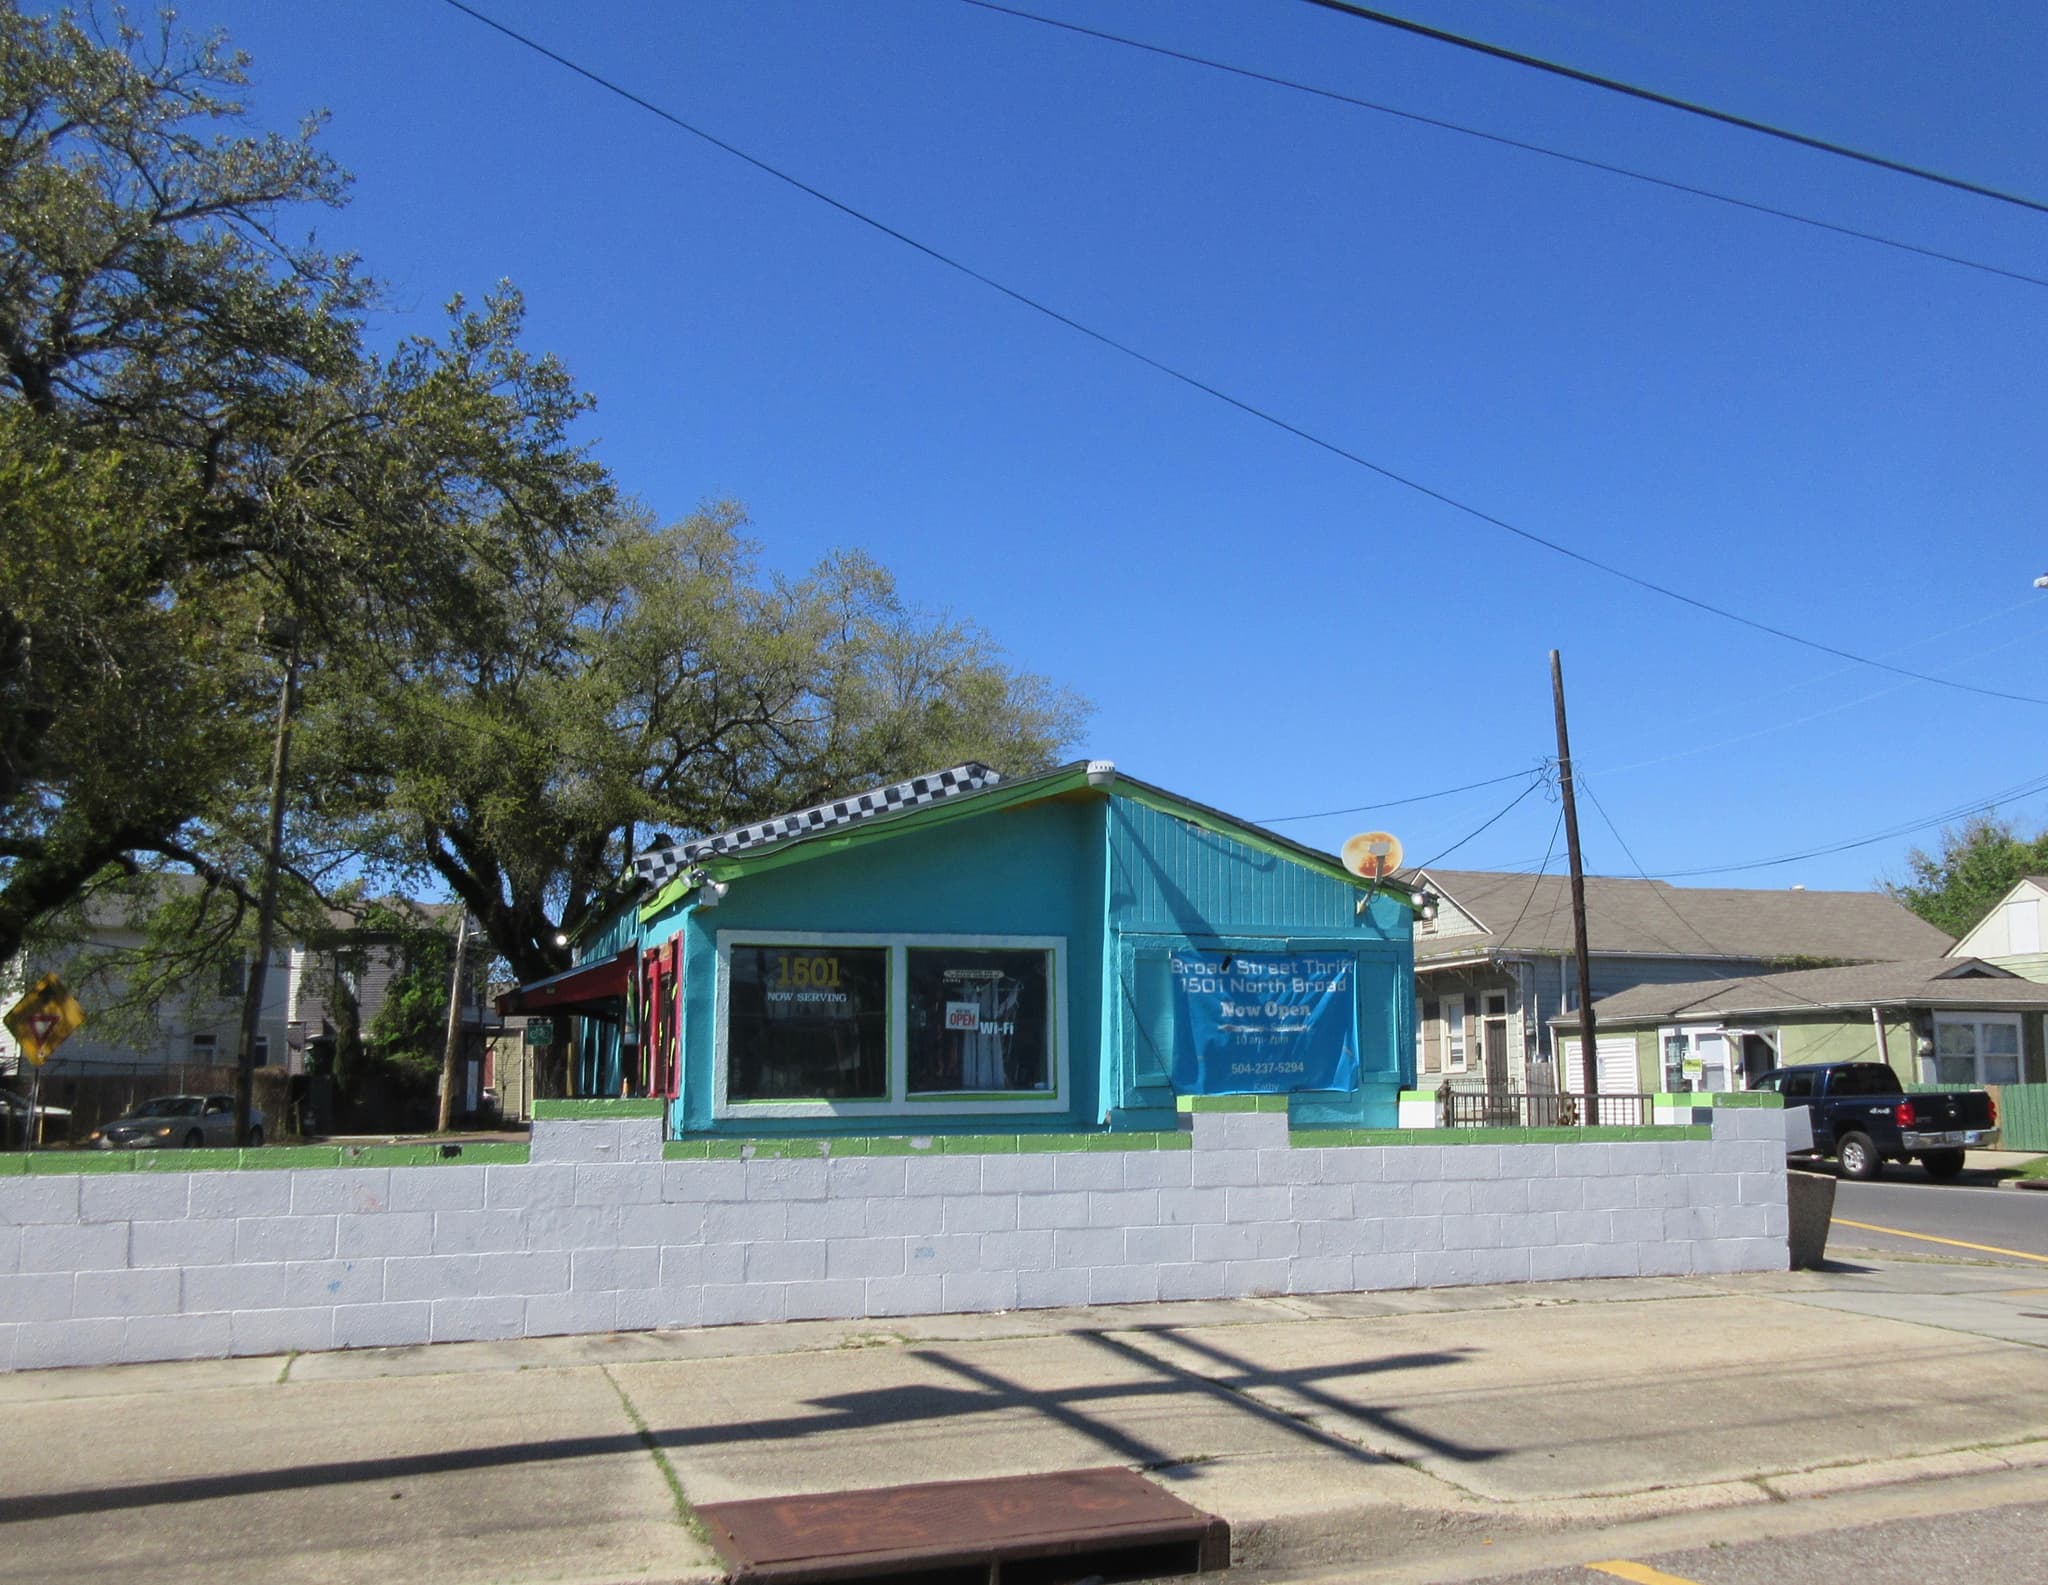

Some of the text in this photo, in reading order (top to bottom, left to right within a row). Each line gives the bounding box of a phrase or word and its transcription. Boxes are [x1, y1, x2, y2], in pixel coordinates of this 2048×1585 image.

[777, 957, 841, 987] 1501
[1170, 959, 1353, 975] Broad Street Thrift
[1181, 978, 1346, 993] 1501 North Broad
[767, 992, 848, 1002] NOW SERVING
[1220, 1001, 1311, 1020] Now Open
[950, 1013, 976, 1026] OPEN
[980, 1022, 1014, 1035] Wi-Fi
[1231, 1061, 1305, 1075] 504-237-5294
